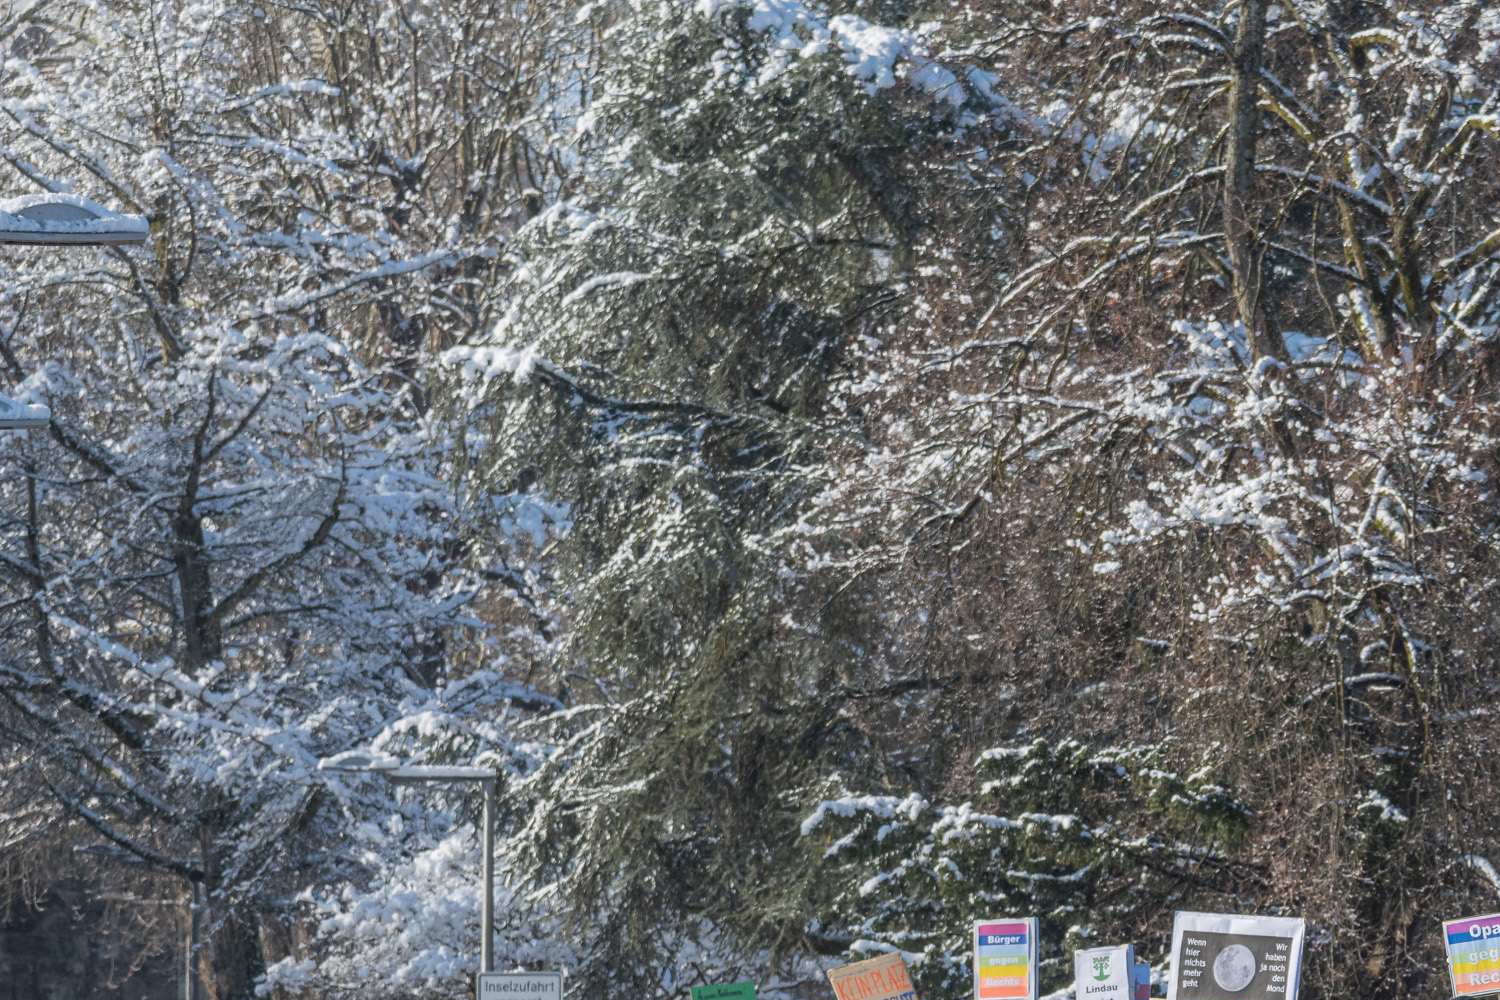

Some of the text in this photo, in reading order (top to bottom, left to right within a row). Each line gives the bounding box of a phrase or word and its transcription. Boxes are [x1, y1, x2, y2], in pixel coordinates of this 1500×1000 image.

[987, 935, 1020, 945] Bürger
[1187, 937, 1207, 947] Wenn
[1185, 947, 1201, 957] hier
[1276, 943, 1288, 952] Wir
[989, 956, 1018, 966] gegen
[1265, 952, 1287, 962] haben
[1184, 957, 1207, 968] nichts
[1259, 962, 1286, 973] ja noch
[1183, 968, 1203, 977] mehr
[871, 962, 911, 994] PLATZ
[986, 978, 1020, 987] Rechts
[1272, 974, 1285, 983] den
[485, 981, 555, 992] Inselzufahrt
[1086, 984, 1118, 994] Lindau
[1182, 979, 1199, 989] geht
[1266, 983, 1285, 993] Mond
